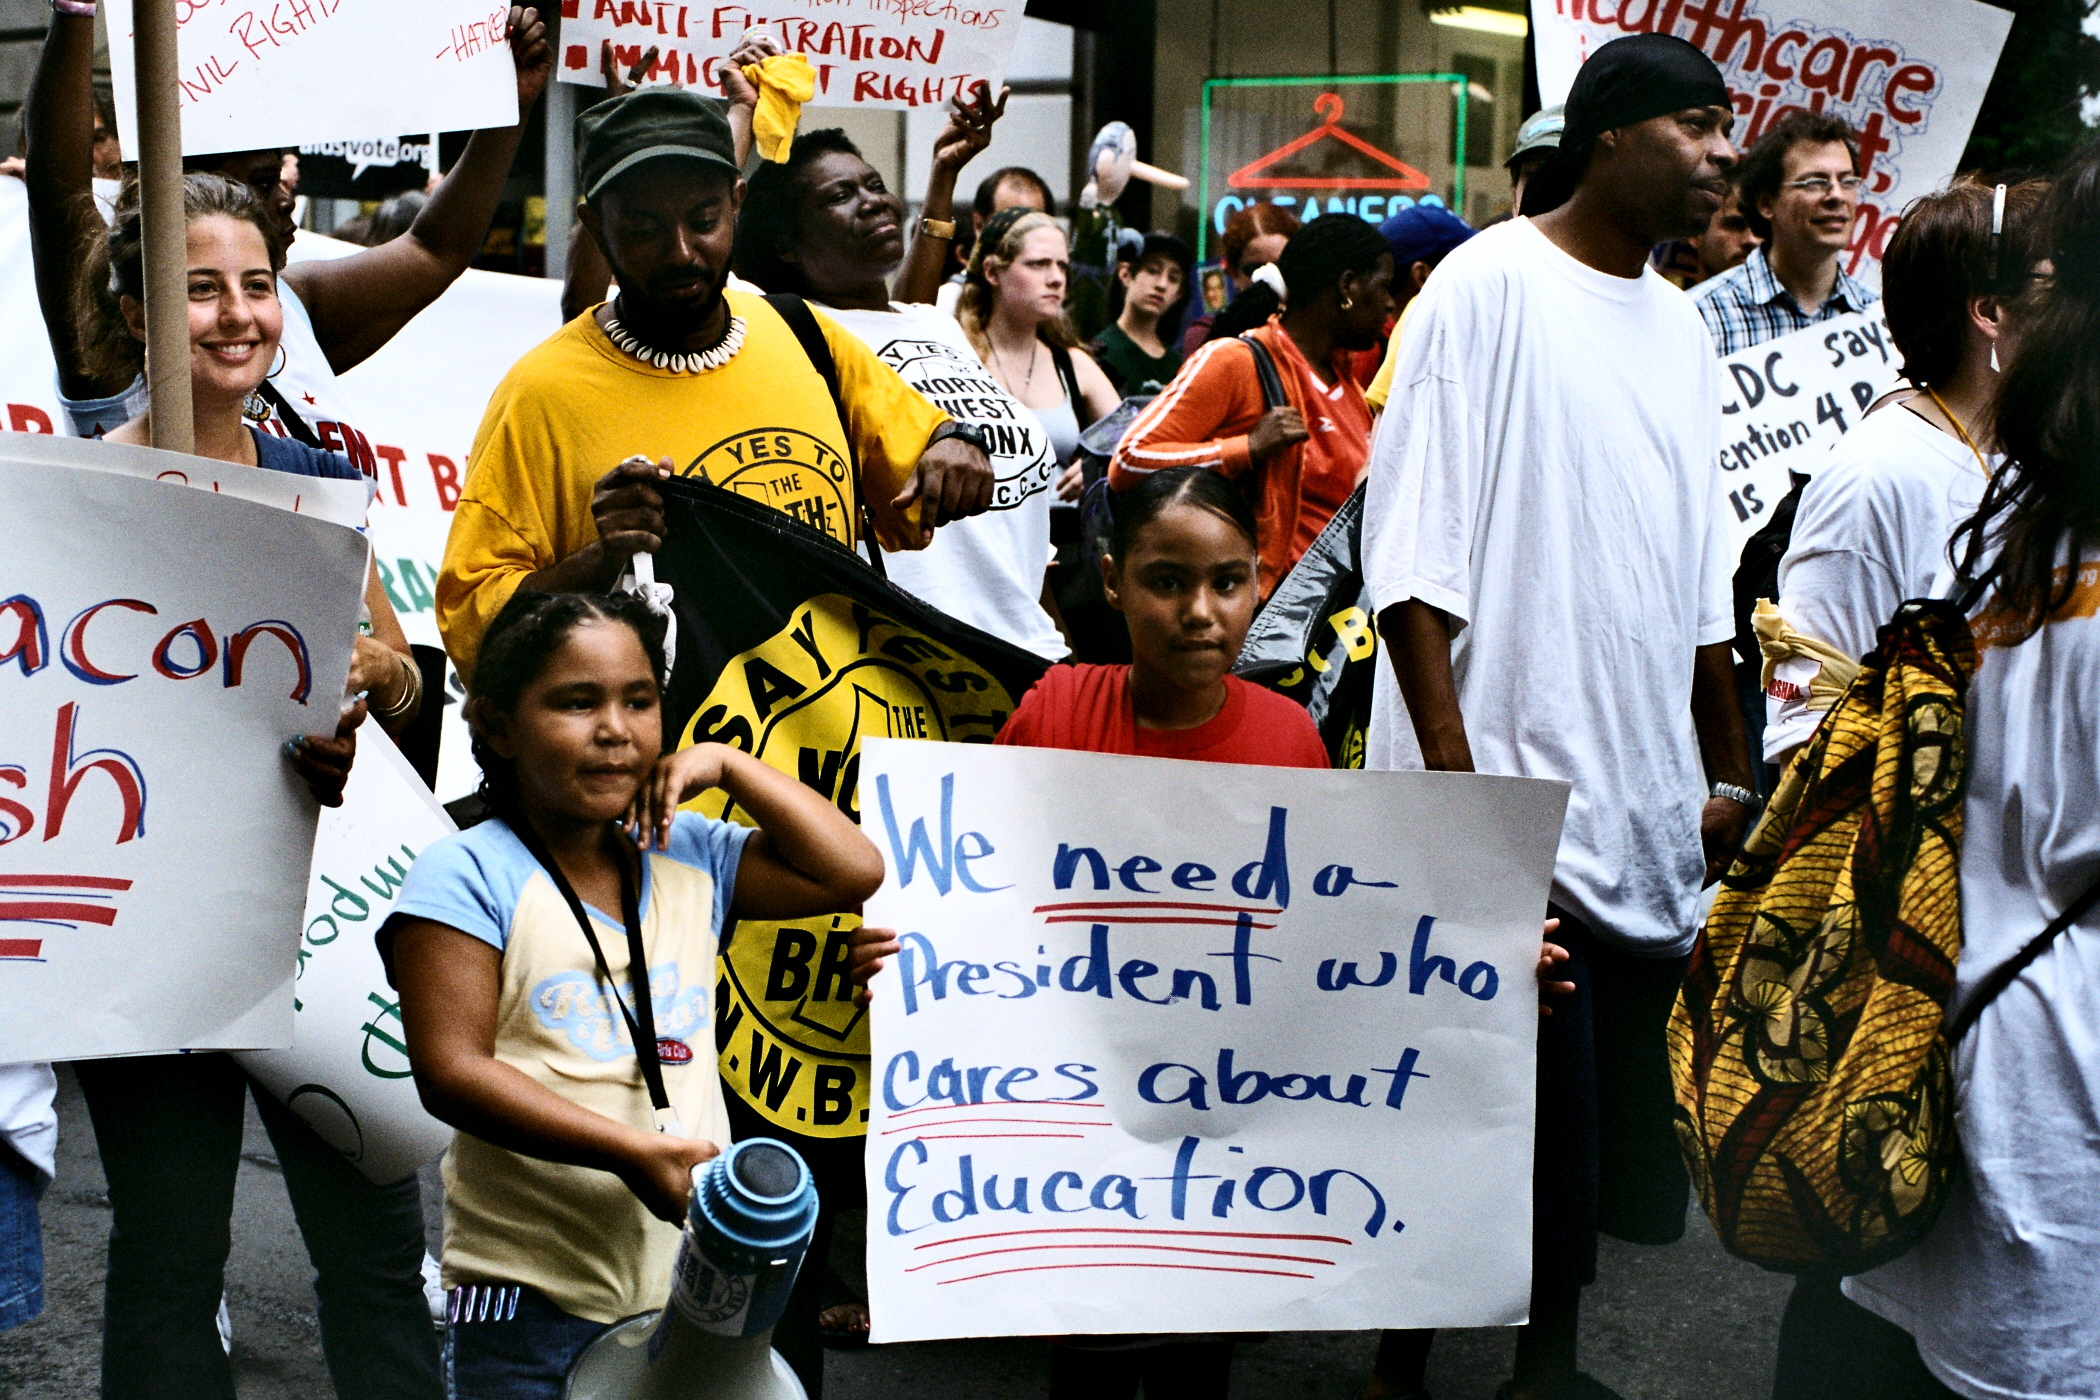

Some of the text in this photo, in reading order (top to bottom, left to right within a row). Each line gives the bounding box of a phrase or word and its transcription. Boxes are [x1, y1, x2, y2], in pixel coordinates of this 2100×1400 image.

[1721, 351, 1800, 415] DC
[1815, 391, 1849, 436] 4
[725, 435, 846, 483] YES TO
[769, 473, 803, 497] THE
[691, 609, 833, 753] SAY
[851, 601, 990, 693] YES
[891, 705, 928, 739] THE
[876, 772, 1400, 910] We need a
[897, 911, 1502, 1016] President who
[882, 1046, 1432, 1114] Cares about
[884, 1134, 1407, 1239] Education.
